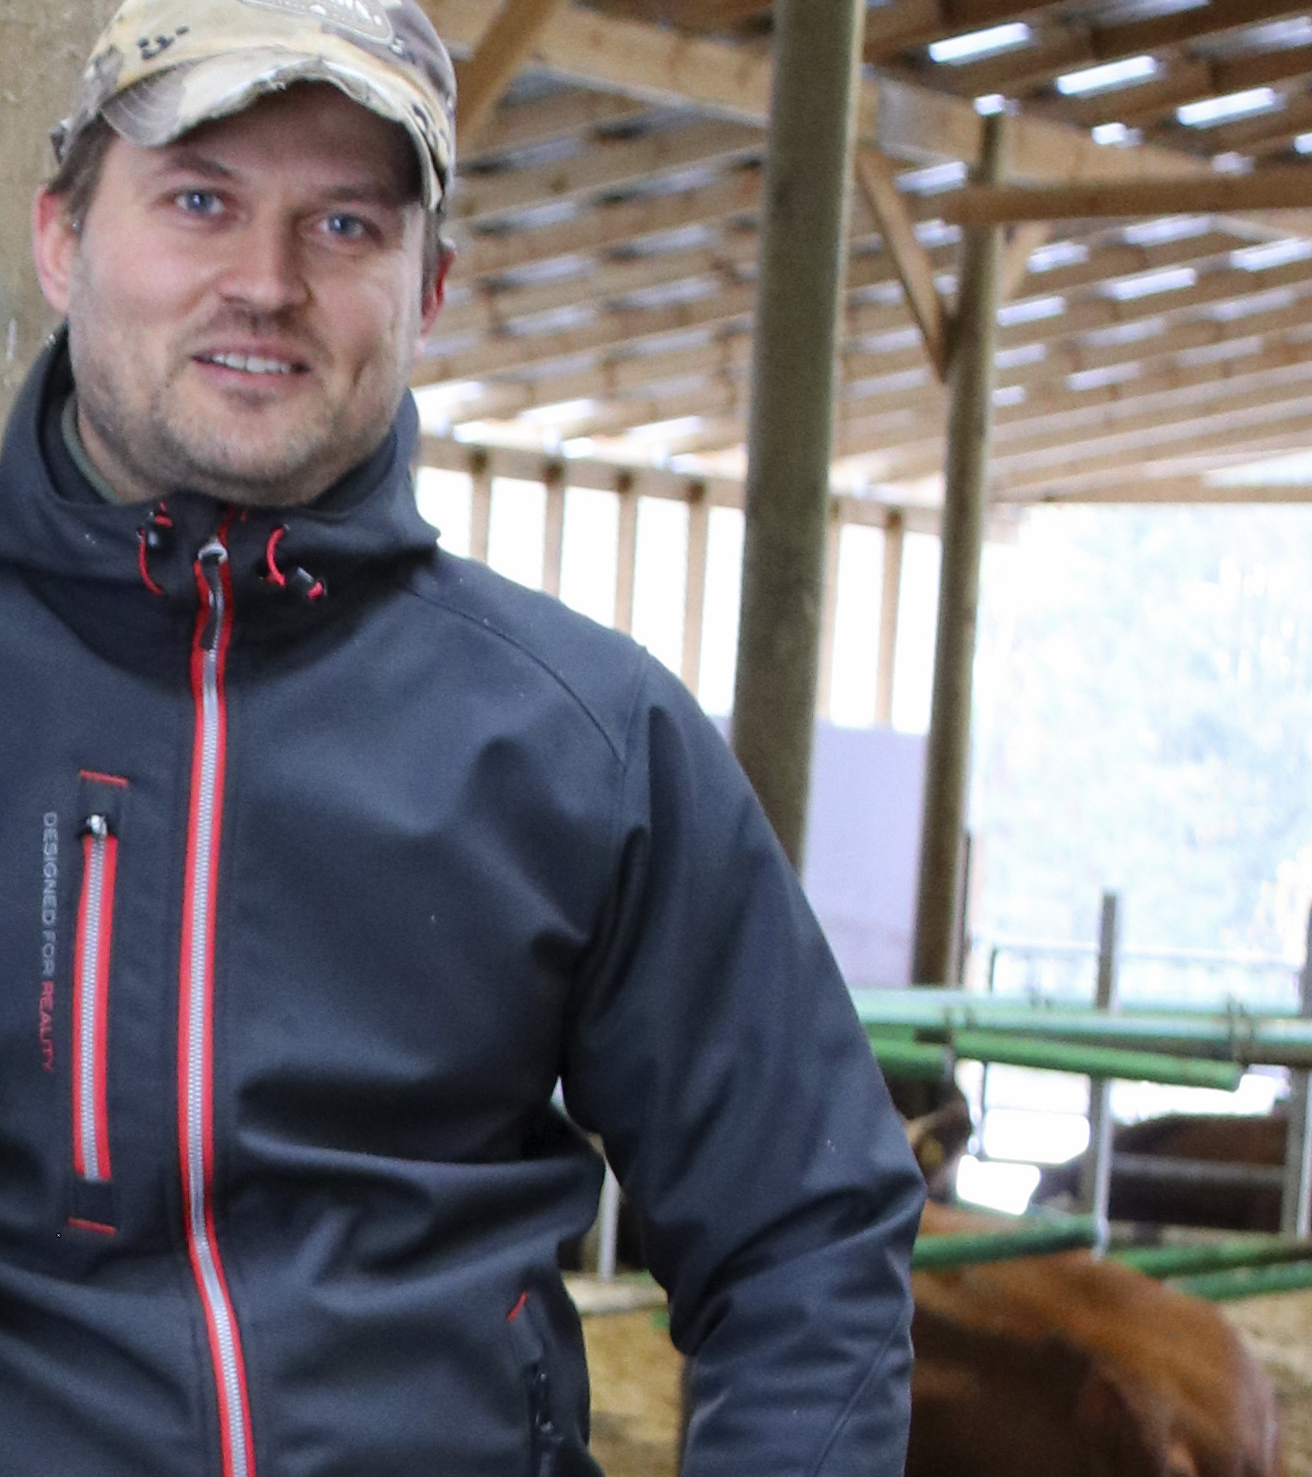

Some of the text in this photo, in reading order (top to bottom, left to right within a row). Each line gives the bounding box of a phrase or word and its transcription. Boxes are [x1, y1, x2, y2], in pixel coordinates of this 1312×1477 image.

[38, 811, 58, 1073] DESIGNED FOR REALITY
